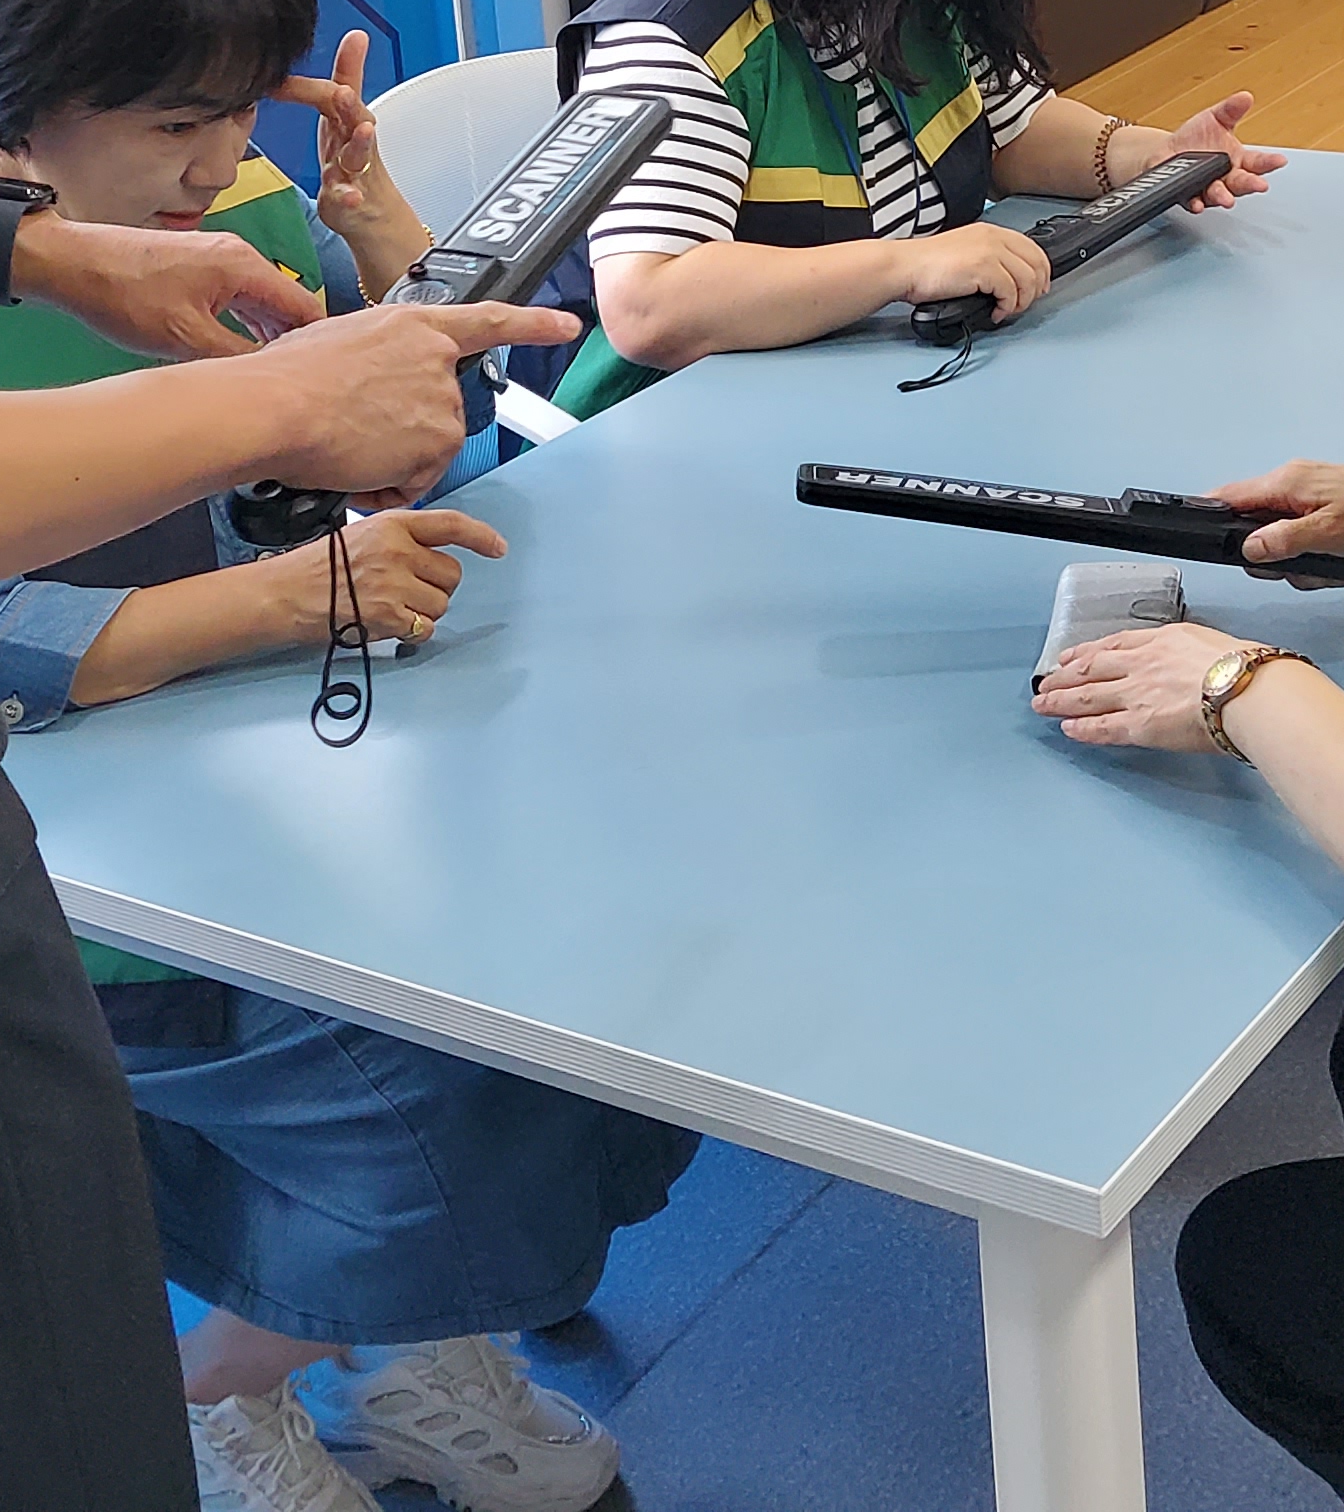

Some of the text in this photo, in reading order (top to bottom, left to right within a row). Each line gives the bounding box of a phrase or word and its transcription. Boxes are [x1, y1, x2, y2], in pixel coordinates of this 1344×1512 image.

[467, 104, 626, 244] SCANNER
[1082, 157, 1199, 216] SCANNER
[835, 471, 1085, 508] SCANNER
